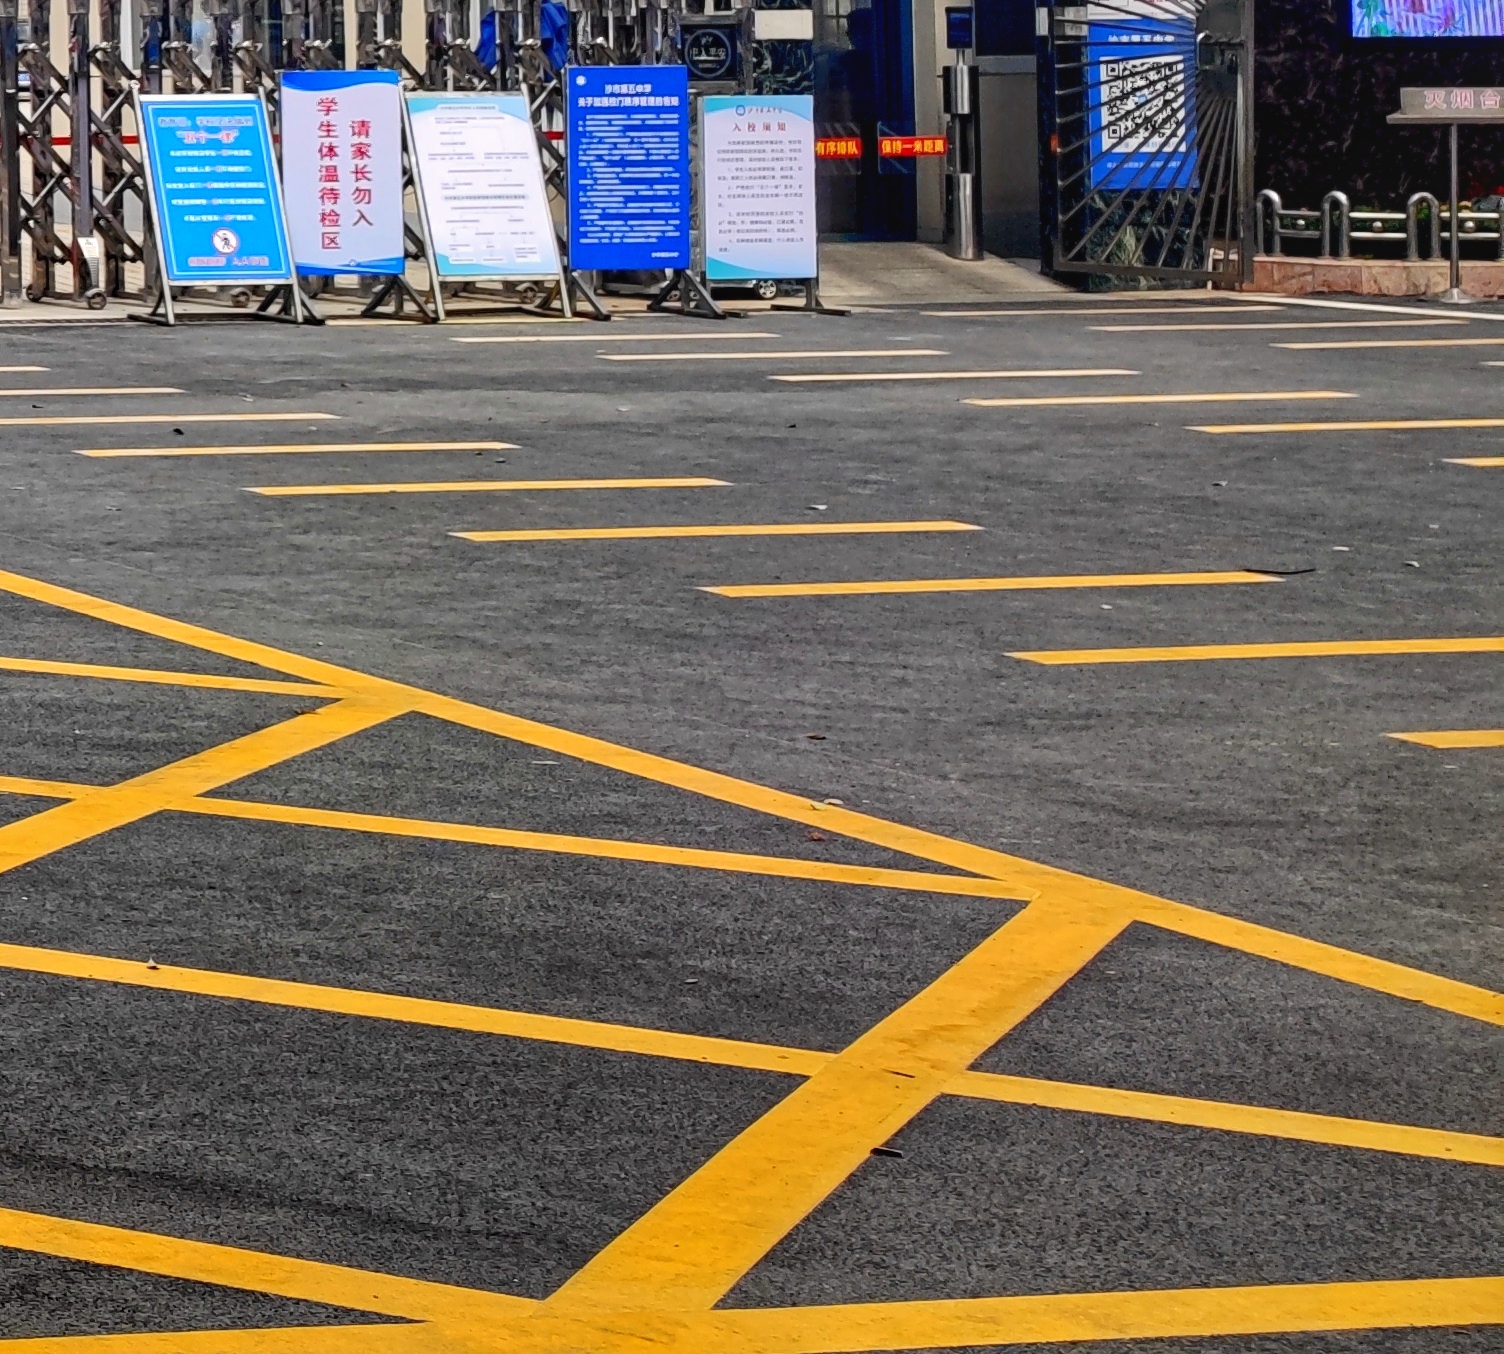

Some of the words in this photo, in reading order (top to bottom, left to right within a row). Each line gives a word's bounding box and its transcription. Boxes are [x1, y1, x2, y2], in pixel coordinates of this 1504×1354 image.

[1424, 89, 1501, 110] 灭烟台
[732, 122, 787, 133] 入校须知
[816, 141, 859, 156] 有序排队
[882, 140, 944, 154] 保持一米距离
[317, 98, 341, 250] 学生体温待检区
[350, 120, 373, 227] 请家长勿入
